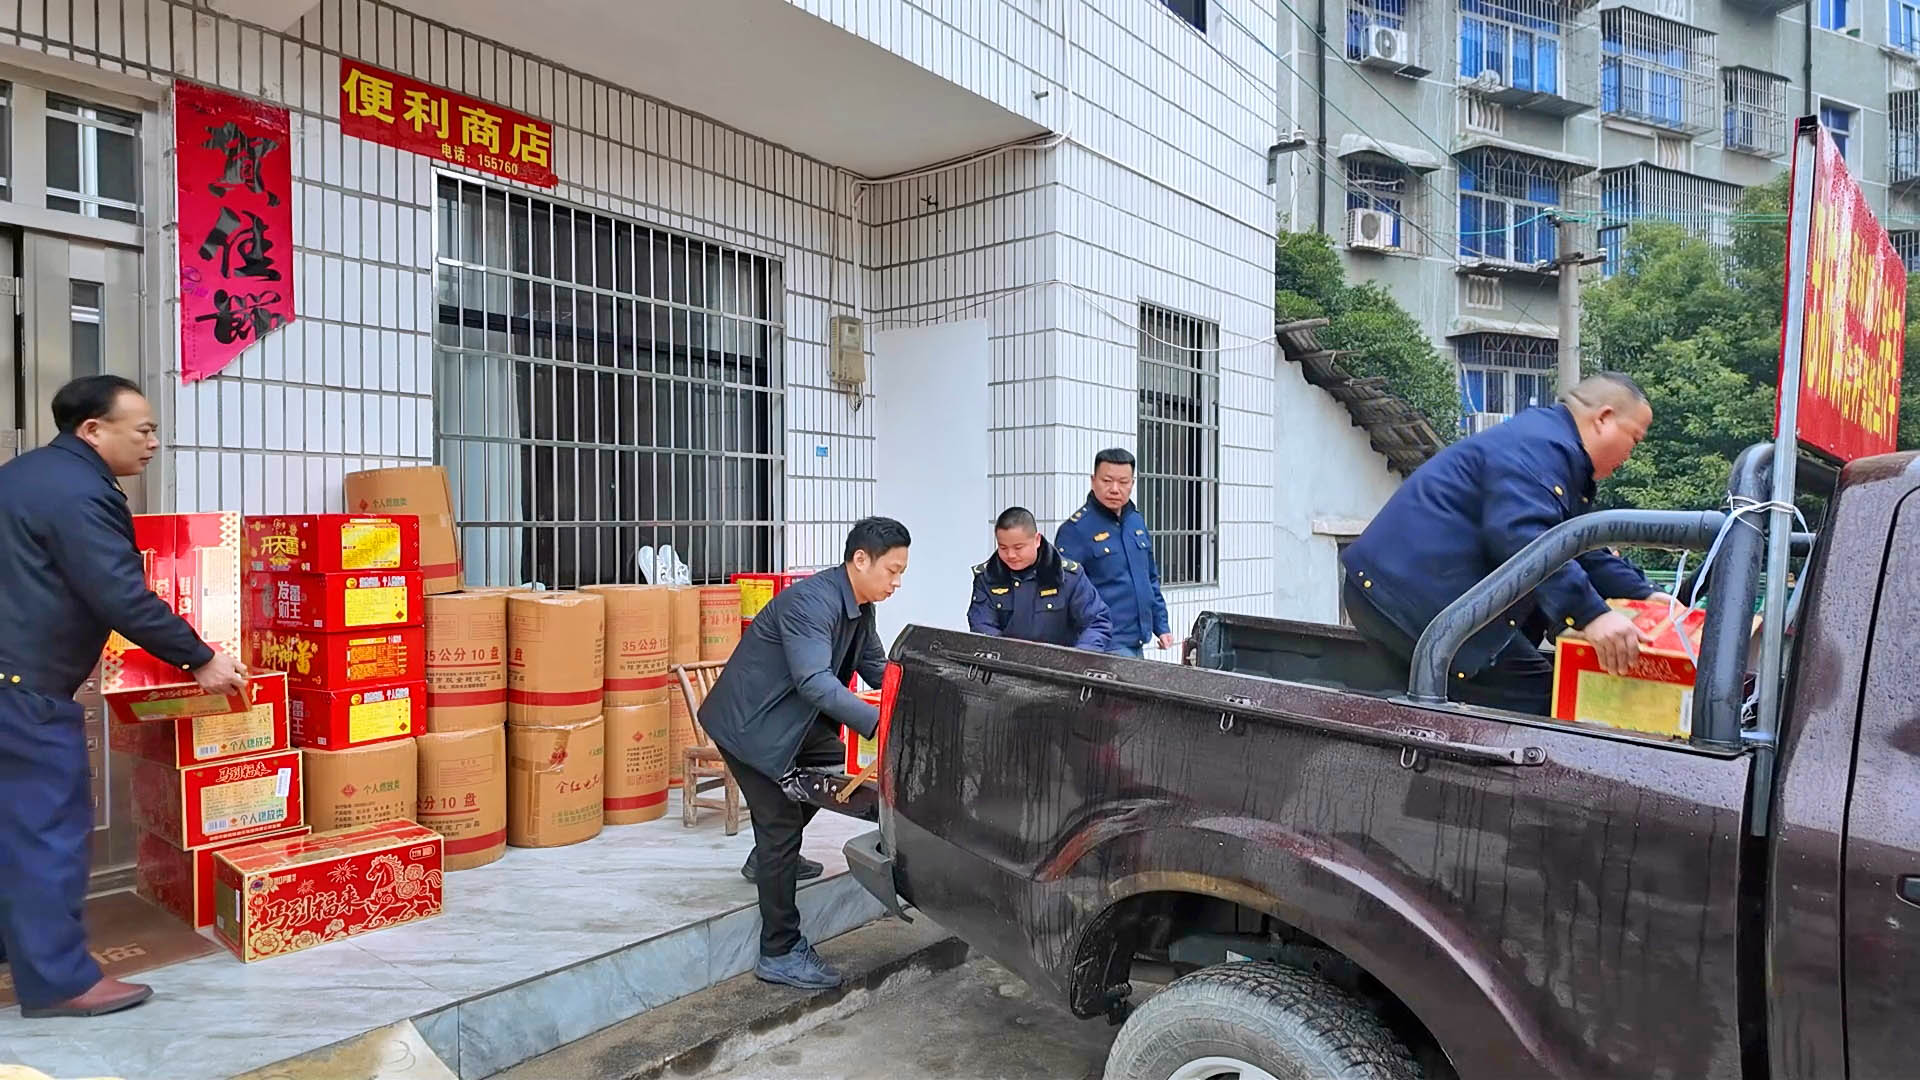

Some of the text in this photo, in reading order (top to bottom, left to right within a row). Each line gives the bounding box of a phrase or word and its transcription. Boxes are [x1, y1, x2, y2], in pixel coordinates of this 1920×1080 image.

[342, 68, 550, 168] 便利商店
[442, 796, 457, 809] 10
[263, 884, 362, 931] 马到福来
